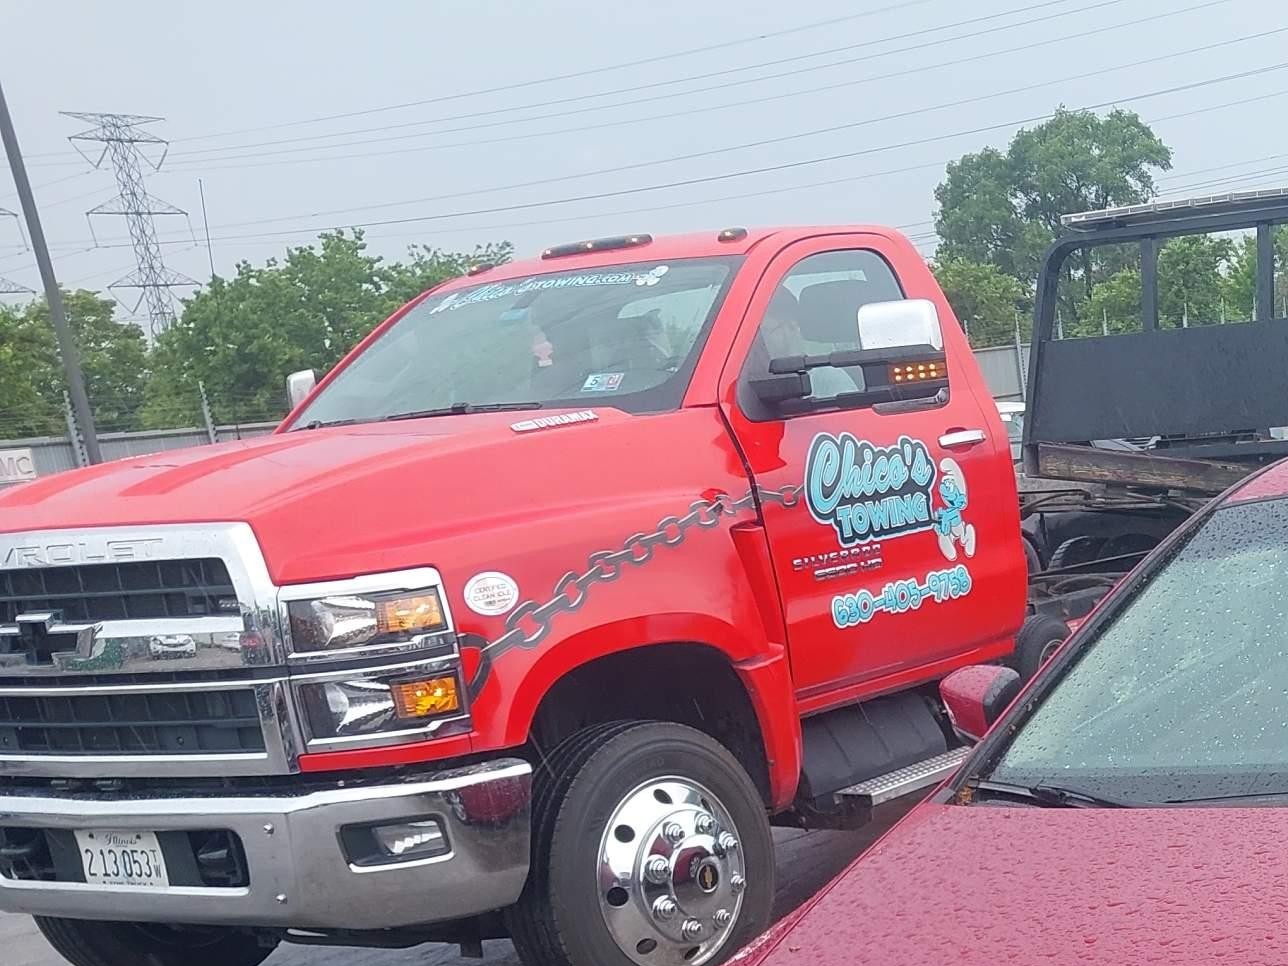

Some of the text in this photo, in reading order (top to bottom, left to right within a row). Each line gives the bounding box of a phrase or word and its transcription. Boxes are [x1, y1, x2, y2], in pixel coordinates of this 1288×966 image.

[533, 410, 599, 428] DURAMAX
[809, 438, 933, 515] Chico's
[836, 493, 929, 538] TOWING
[832, 565, 972, 628] 630-405-9758
